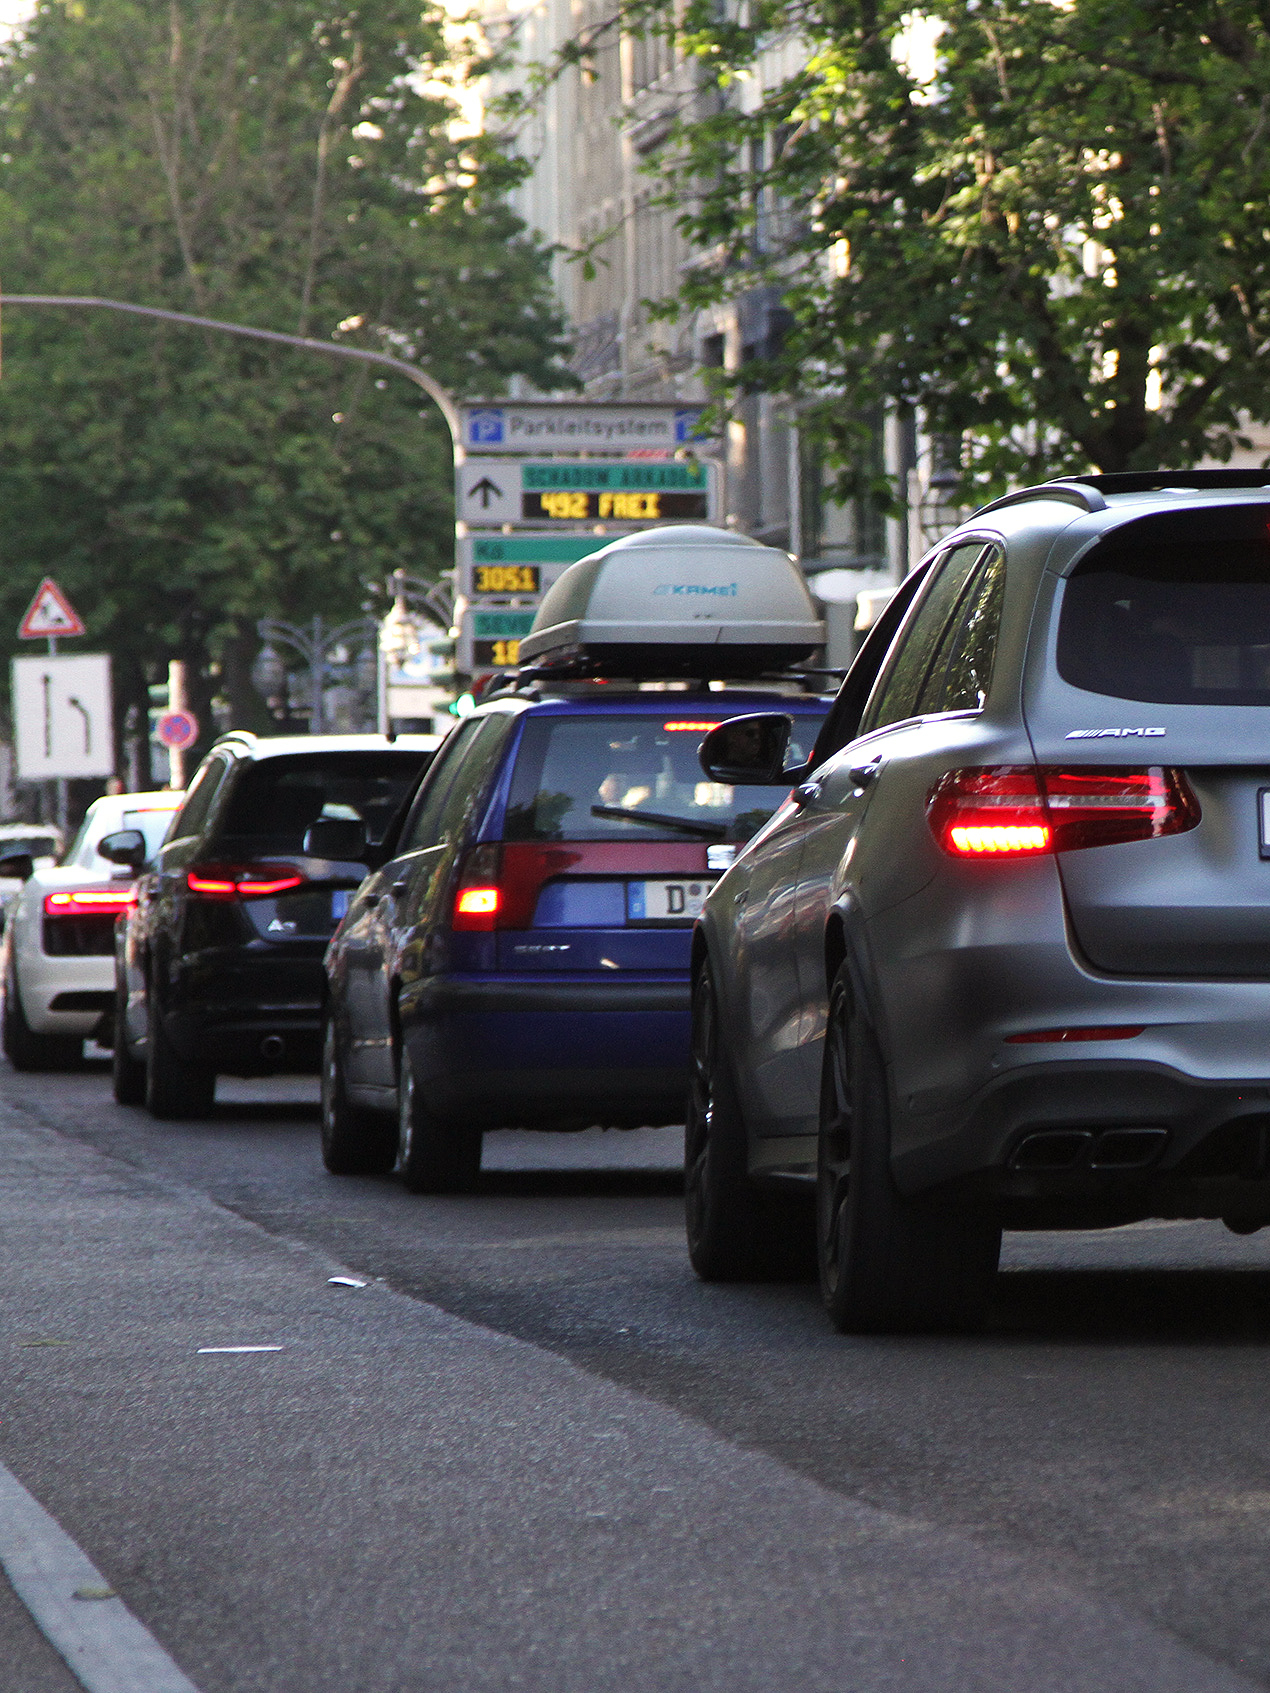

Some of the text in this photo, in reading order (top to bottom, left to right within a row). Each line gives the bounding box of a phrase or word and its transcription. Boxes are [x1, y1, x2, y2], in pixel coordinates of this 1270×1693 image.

[509, 417, 669, 439] Parkleitsystem
[541, 492, 660, 518] 492 FREI
[477, 566, 536, 592] 3051
[1098, 727, 1167, 738] AMG
[665, 885, 685, 914] D
